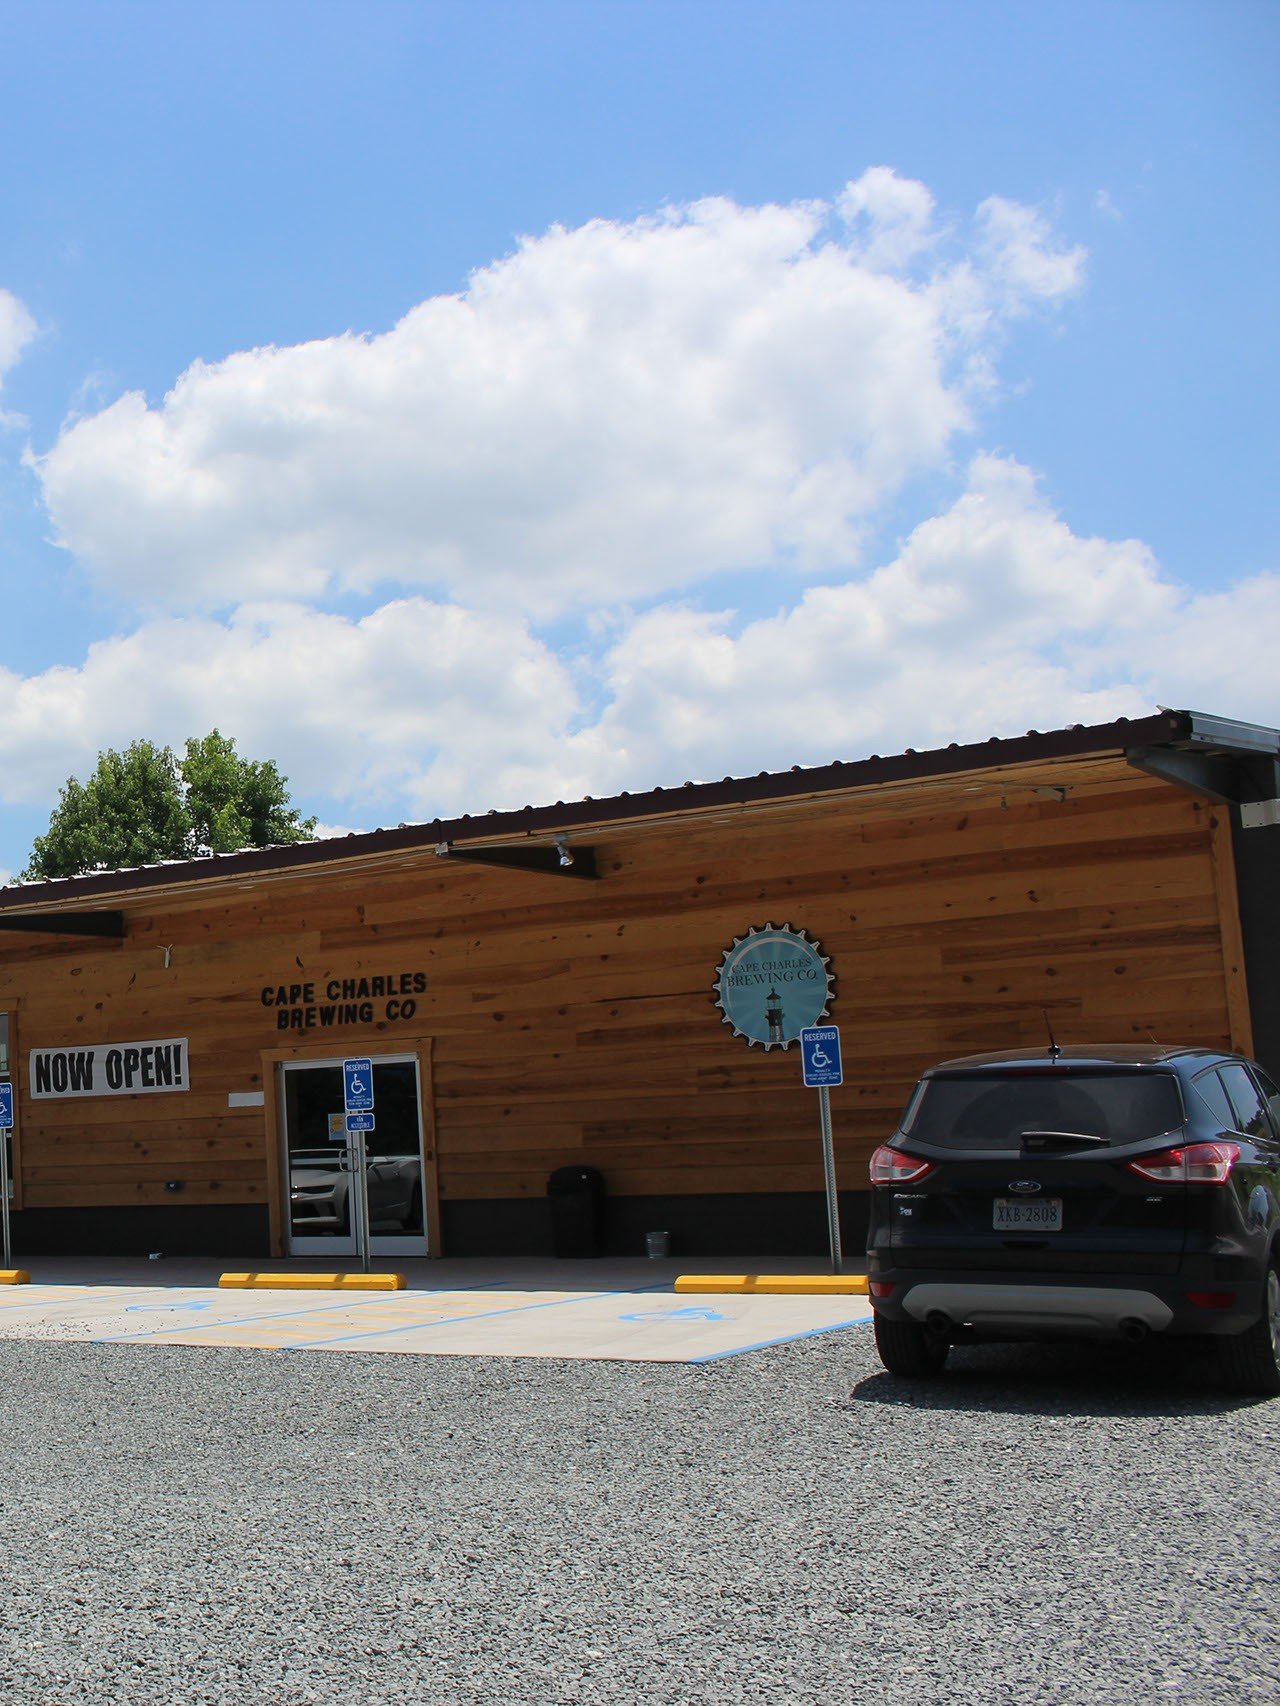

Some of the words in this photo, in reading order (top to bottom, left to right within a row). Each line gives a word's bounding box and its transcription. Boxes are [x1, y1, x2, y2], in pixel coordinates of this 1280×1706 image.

[732, 962, 760, 974] CAPE
[762, 959, 812, 971] CHARLES
[727, 970, 794, 987] BREWING
[261, 982, 315, 1007] CAPE
[326, 972, 427, 1001] CHARLES
[277, 1002, 374, 1030] BREWING
[385, 999, 417, 1021] CO
[804, 1032, 836, 1041] RESERVED
[35, 1051, 95, 1093] NOW
[105, 1044, 182, 1090] OPEN!
[346, 1063, 370, 1072] RESERVED
